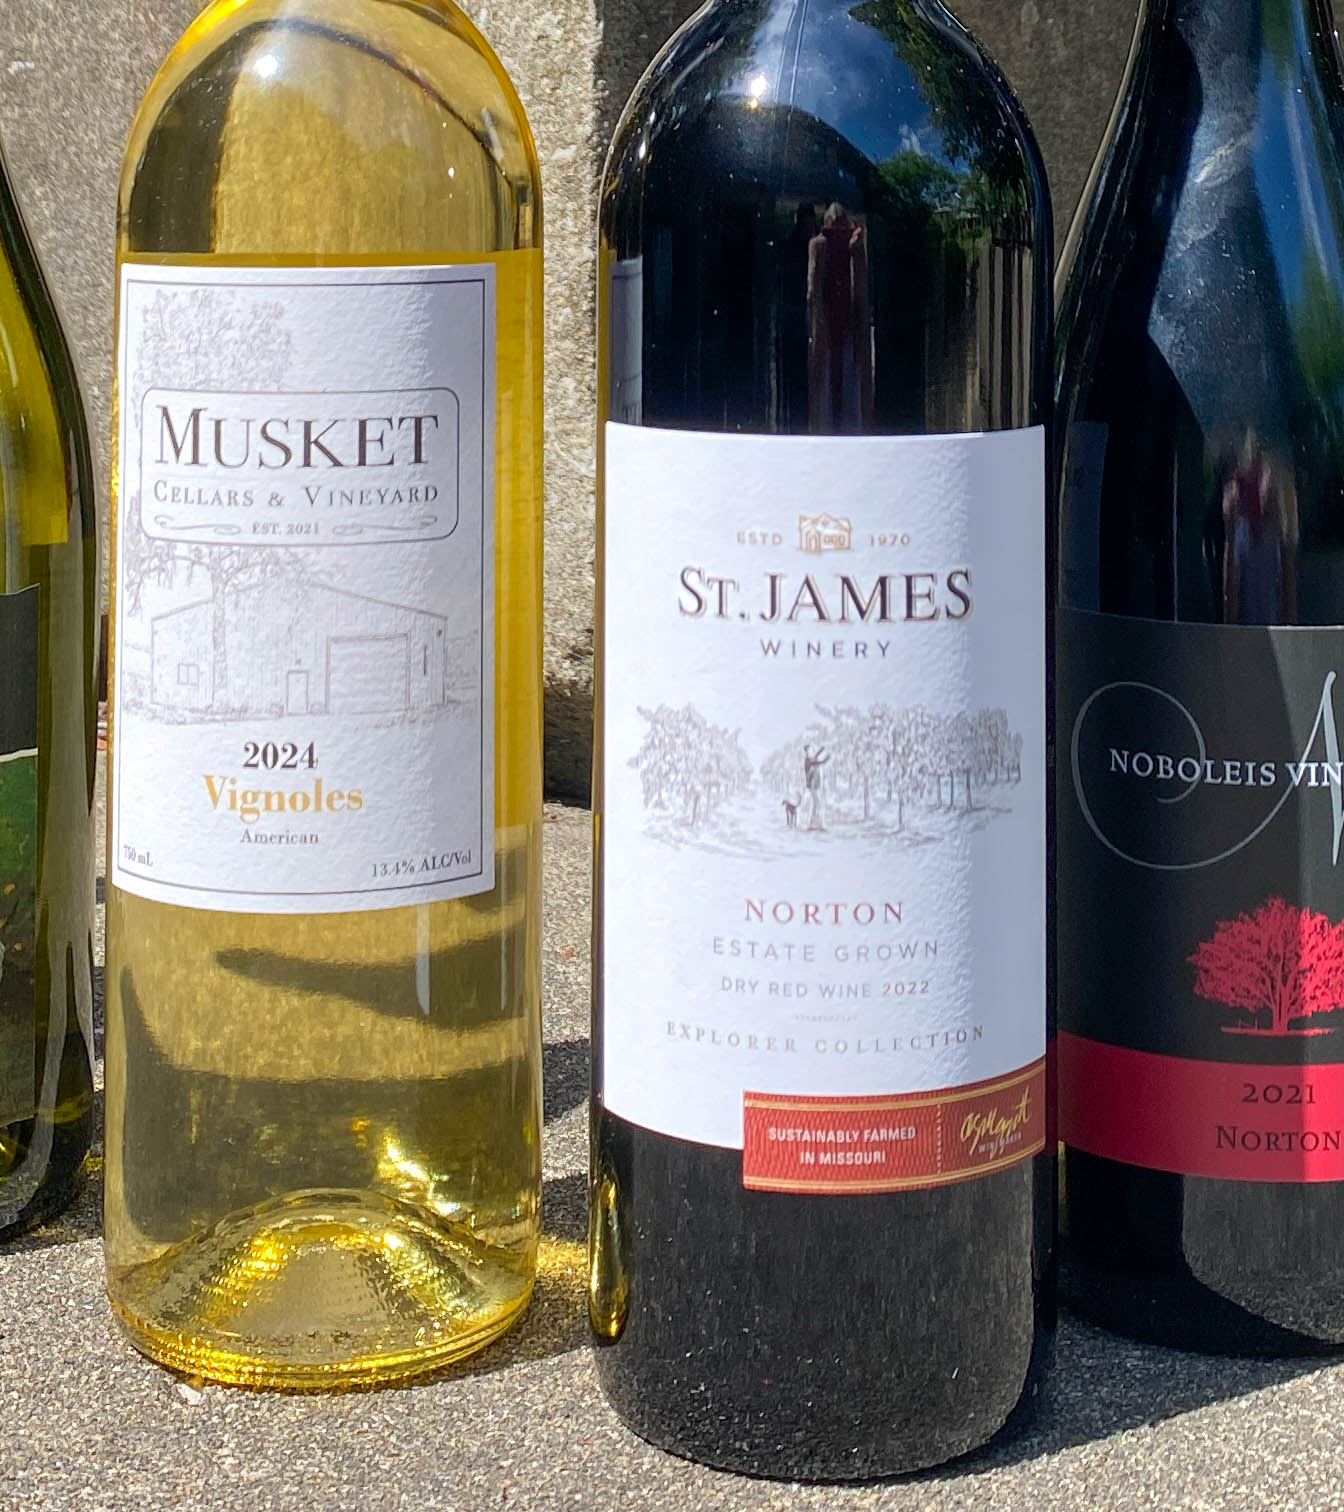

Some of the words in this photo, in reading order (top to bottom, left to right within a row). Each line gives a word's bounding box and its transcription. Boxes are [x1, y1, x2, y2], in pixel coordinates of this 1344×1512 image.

[155, 405, 439, 469] MUSKET
[154, 479, 253, 506] CELLARS
[268, 491, 286, 507] &
[305, 486, 438, 506] VINEYARD
[252, 522, 281, 535] EST.
[286, 522, 320, 535] 2021
[736, 532, 783, 546] ESTD
[869, 534, 911, 546] 1970
[759, 568, 974, 622] JAMES
[760, 639, 891, 659] WINERY
[242, 741, 319, 770] 2024
[1109, 749, 1276, 788] NOBOLEIS
[203, 774, 364, 825] Vignoles
[240, 829, 320, 844] American
[372, 861, 416, 878] 13.4%
[420, 849, 472, 874] ALC/Vol
[744, 899, 904, 926] NORTON
[712, 937, 817, 962] ESTATE
[834, 939, 939, 963] GROWN
[721, 977, 759, 996] DRY
[768, 982, 808, 999] RED
[819, 983, 872, 999] WINE
[882, 980, 930, 997] 2022
[666, 1020, 798, 1054] EXPLORER
[814, 1025, 984, 1055] COLLECTION
[1242, 1082, 1316, 1105] 2021
[768, 1127, 859, 1144] SUSTAINABLY
[863, 1126, 916, 1143] FARMED
[1216, 1125, 1343, 1153] NORTON
[800, 1151, 813, 1165] IN
[819, 1151, 887, 1166] MISSOURI
